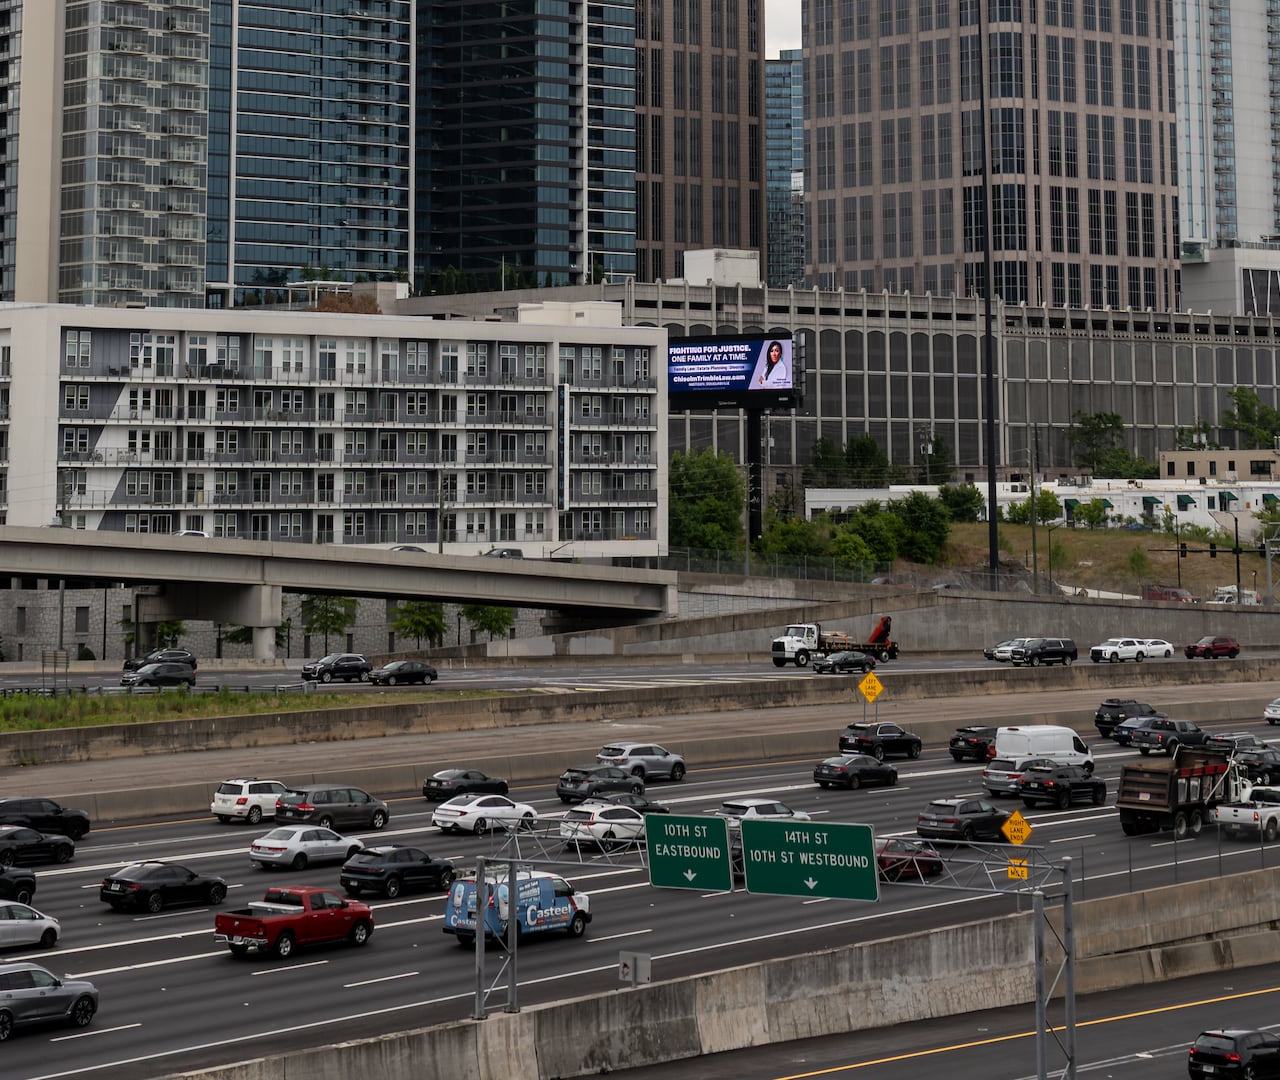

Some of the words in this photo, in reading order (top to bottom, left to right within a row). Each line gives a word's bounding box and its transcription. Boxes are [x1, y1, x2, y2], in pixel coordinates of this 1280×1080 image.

[669, 346, 703, 354] FIGHTING
[687, 354, 712, 362] FAMILY
[729, 353, 748, 361] TIME.
[664, 824, 690, 837] 10TH
[694, 825, 707, 837] ST
[785, 831, 809, 844] 14TH
[814, 832, 828, 845] ST
[655, 844, 721, 859] EASTBOUND
[750, 850, 776, 862] 10TH
[780, 851, 794, 864] ST
[799, 852, 869, 868] WESTBOUND
[527, 904, 571, 926] Casteel
